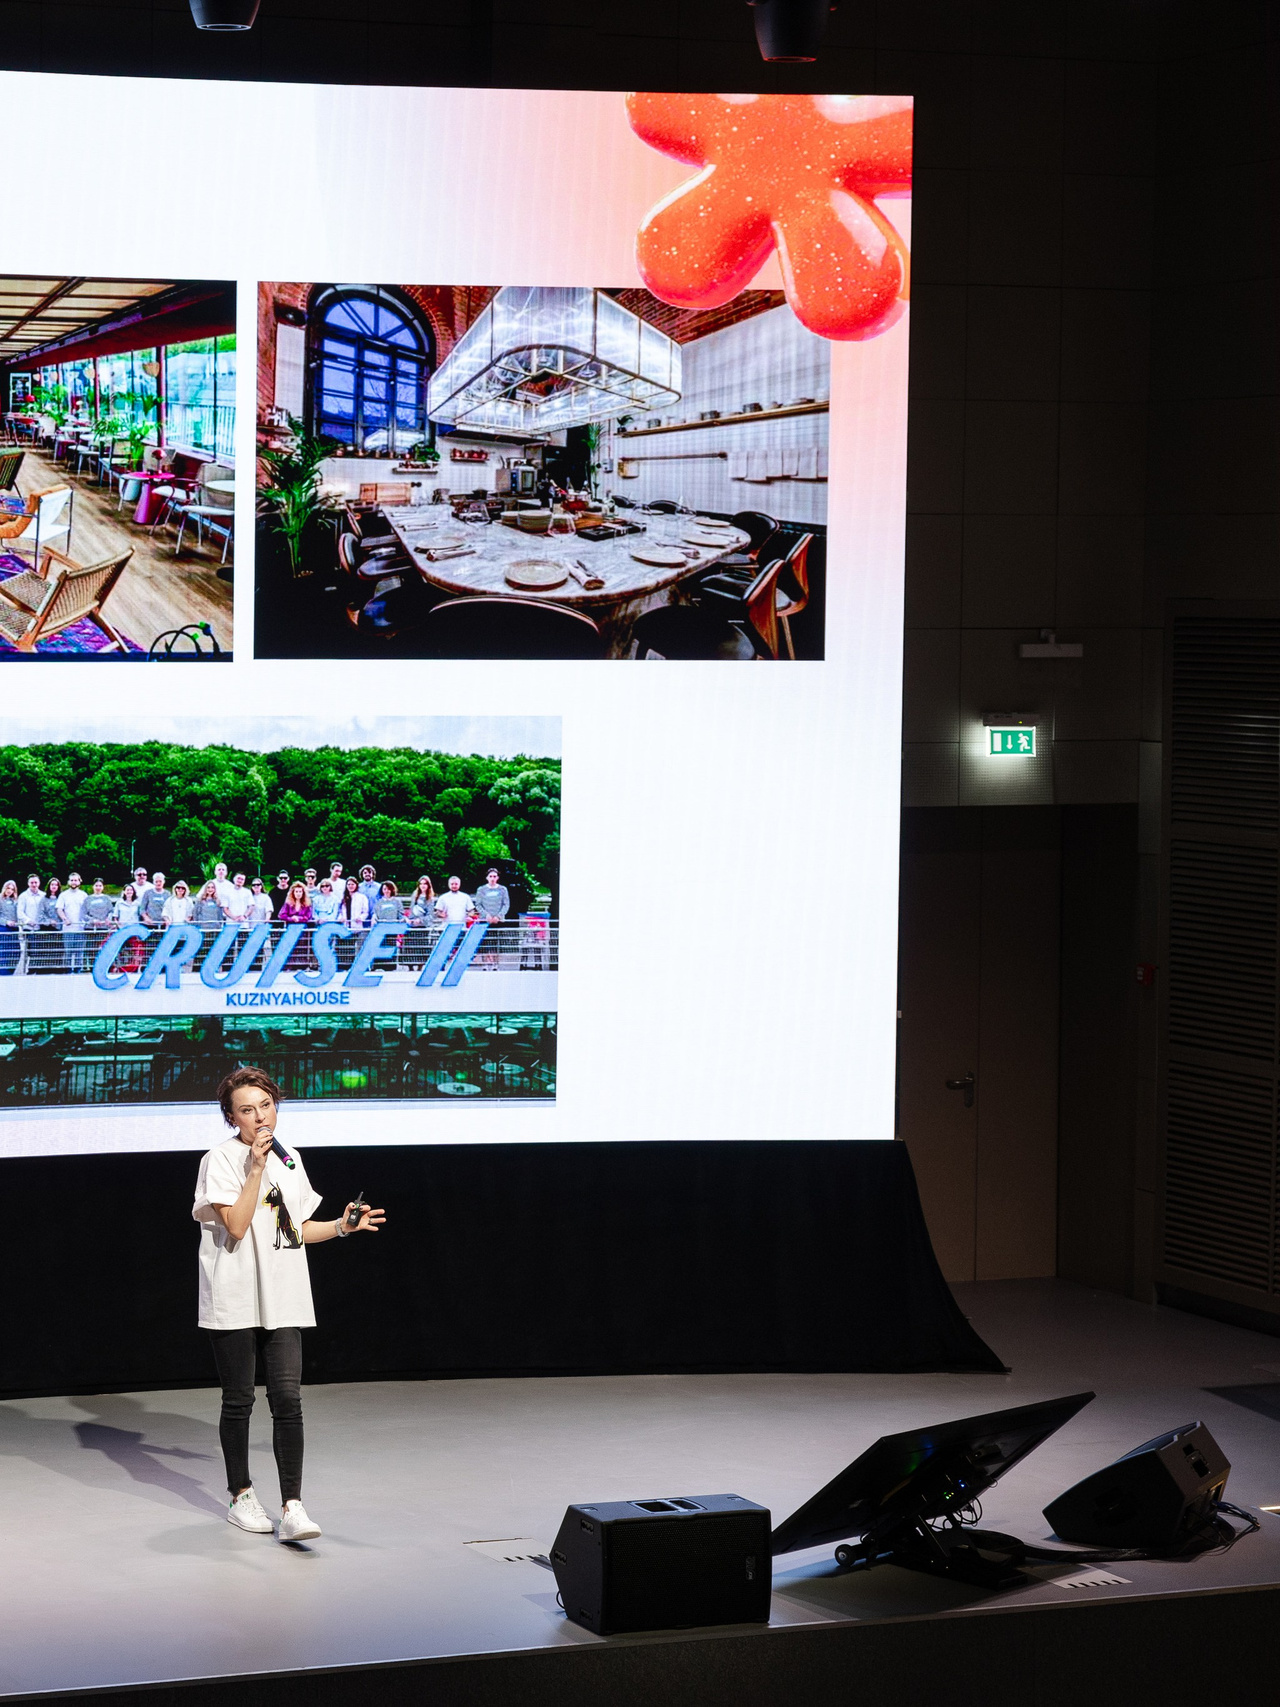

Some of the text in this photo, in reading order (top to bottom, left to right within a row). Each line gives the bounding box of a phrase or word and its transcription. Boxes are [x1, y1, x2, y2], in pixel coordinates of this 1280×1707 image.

[92, 923, 490, 990] CRUISE II
[225, 991, 350, 1007] KUZNYAHOUSE
